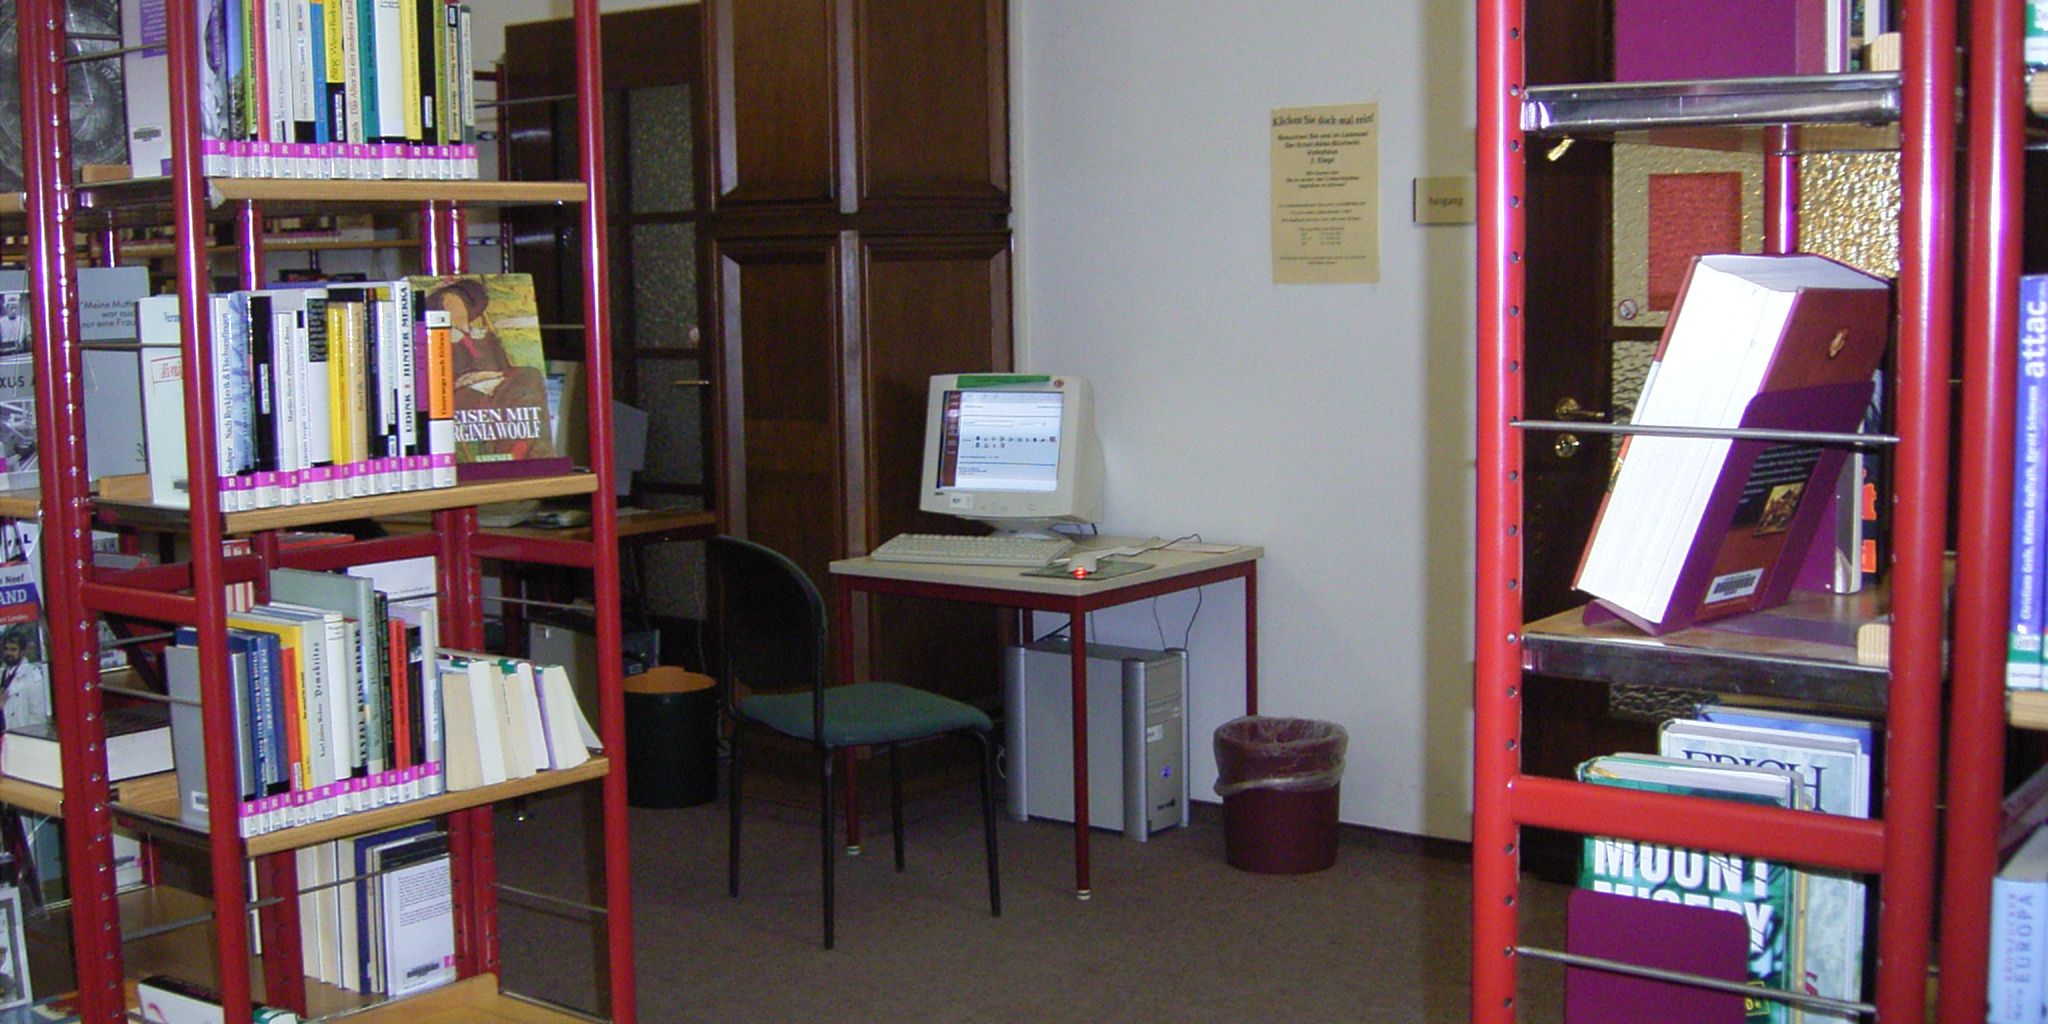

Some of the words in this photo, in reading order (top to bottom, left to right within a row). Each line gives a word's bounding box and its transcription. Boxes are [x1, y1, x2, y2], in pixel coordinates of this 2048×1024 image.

[1272, 114, 1302, 127] Klicken
[1304, 114, 1317, 125] Sie
[1318, 114, 1336, 125] doch
[1339, 114, 1354, 125] mal
[401, 287, 409, 328] MEKKA
[403, 331, 411, 377] HINTER
[2021, 300, 2046, 379] attac
[224, 420, 233, 439] Nach
[404, 393, 412, 433] UDINK
[496, 421, 540, 439] WOOLF
[506, 406, 541, 421] MIT
[2015, 894, 2032, 984] EUROPA
